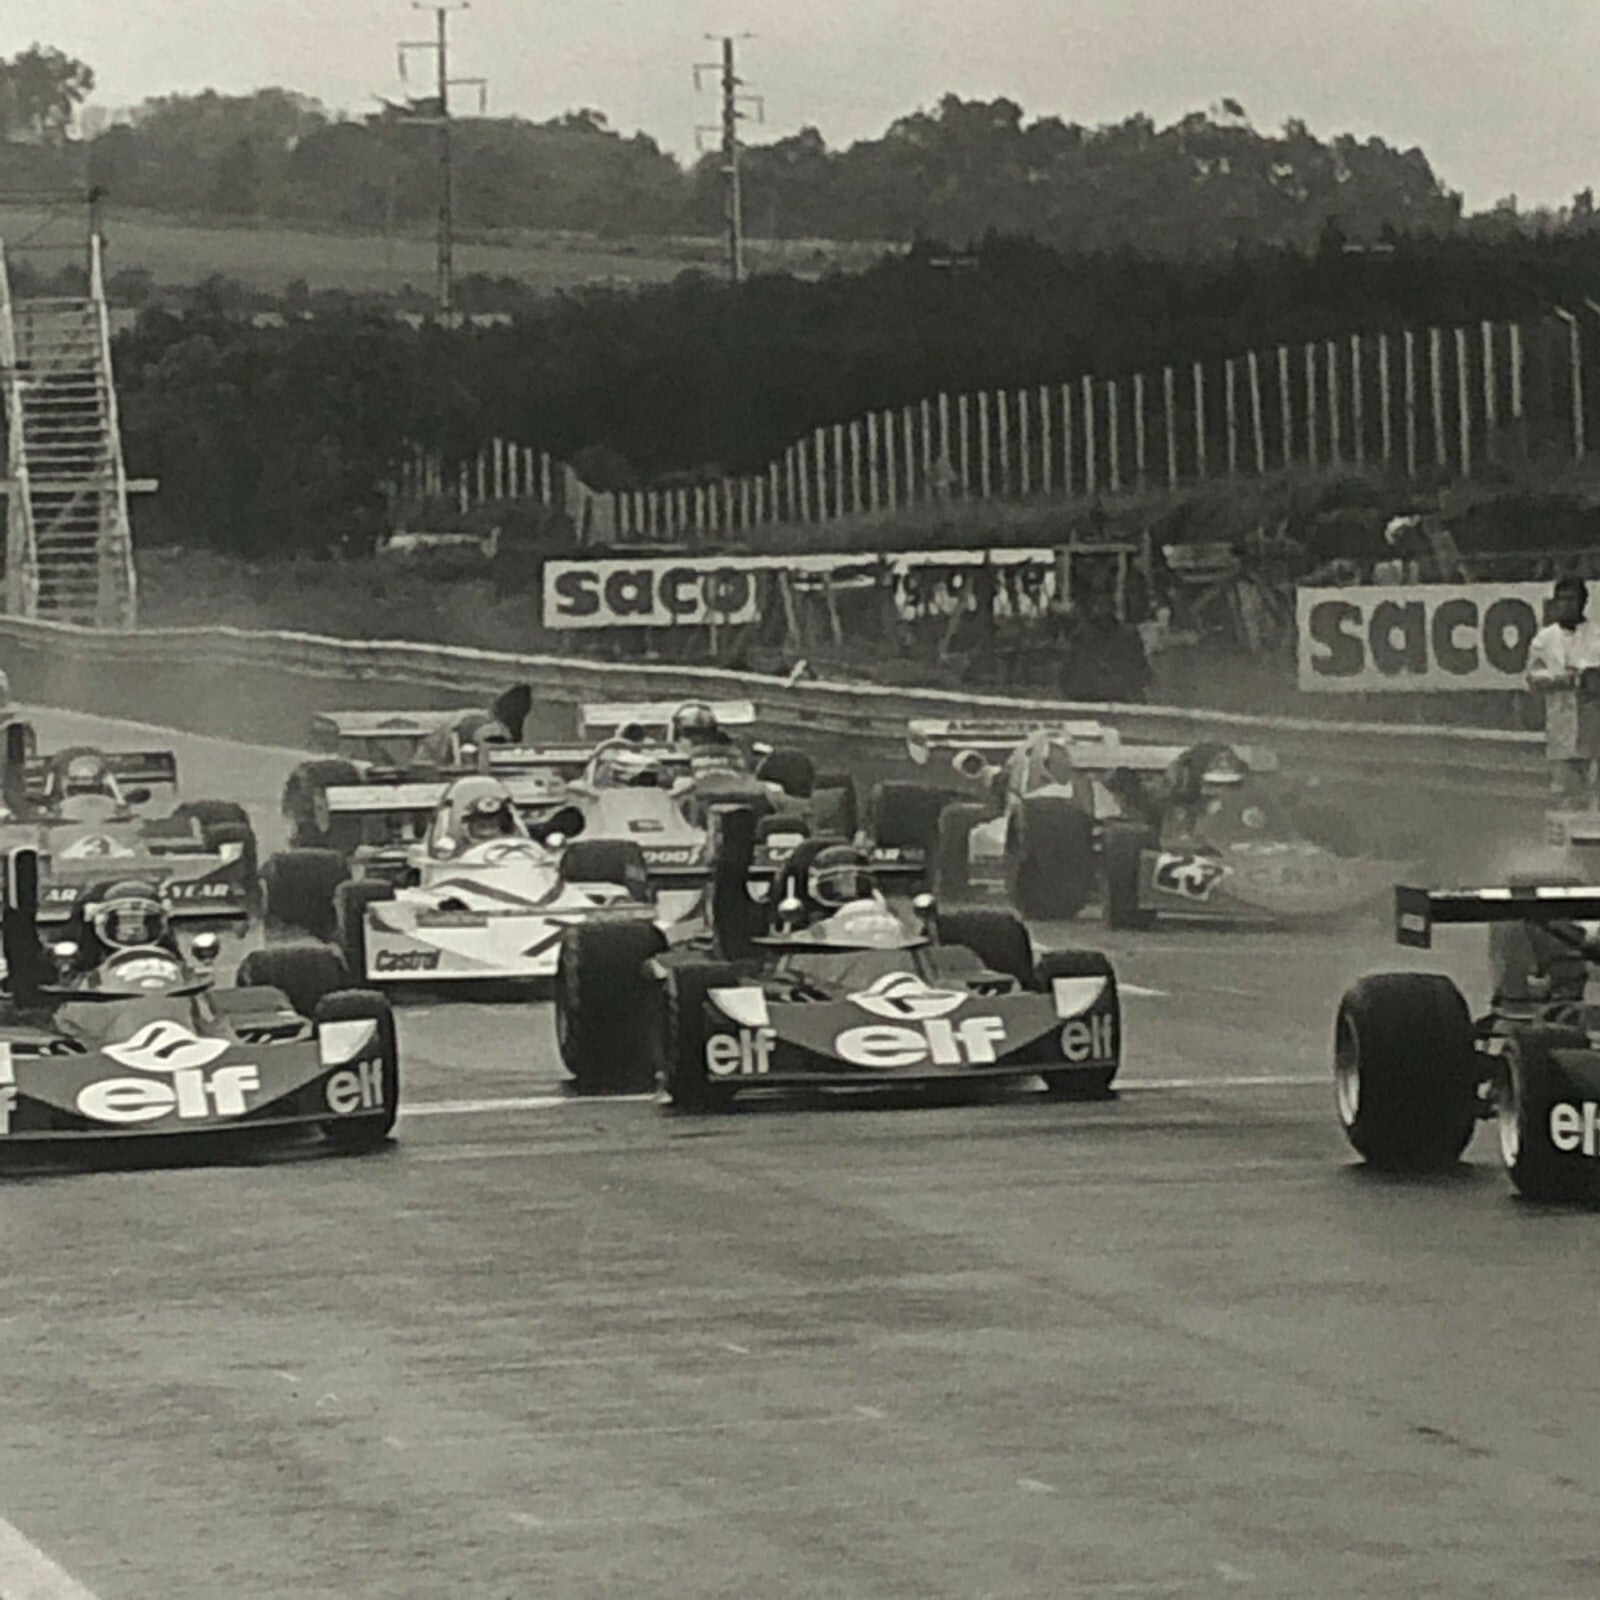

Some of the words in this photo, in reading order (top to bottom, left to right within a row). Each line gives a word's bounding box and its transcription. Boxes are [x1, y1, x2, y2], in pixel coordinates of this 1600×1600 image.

[553, 568, 748, 616] saco
[1309, 598, 1537, 678] saco
[375, 950, 442, 971] Castrol
[707, 1028, 777, 1076] elf
[835, 1016, 1006, 1067] elf
[1061, 1013, 1113, 1061] elf
[77, 1064, 260, 1122] elf
[326, 1058, 384, 1113] elf
